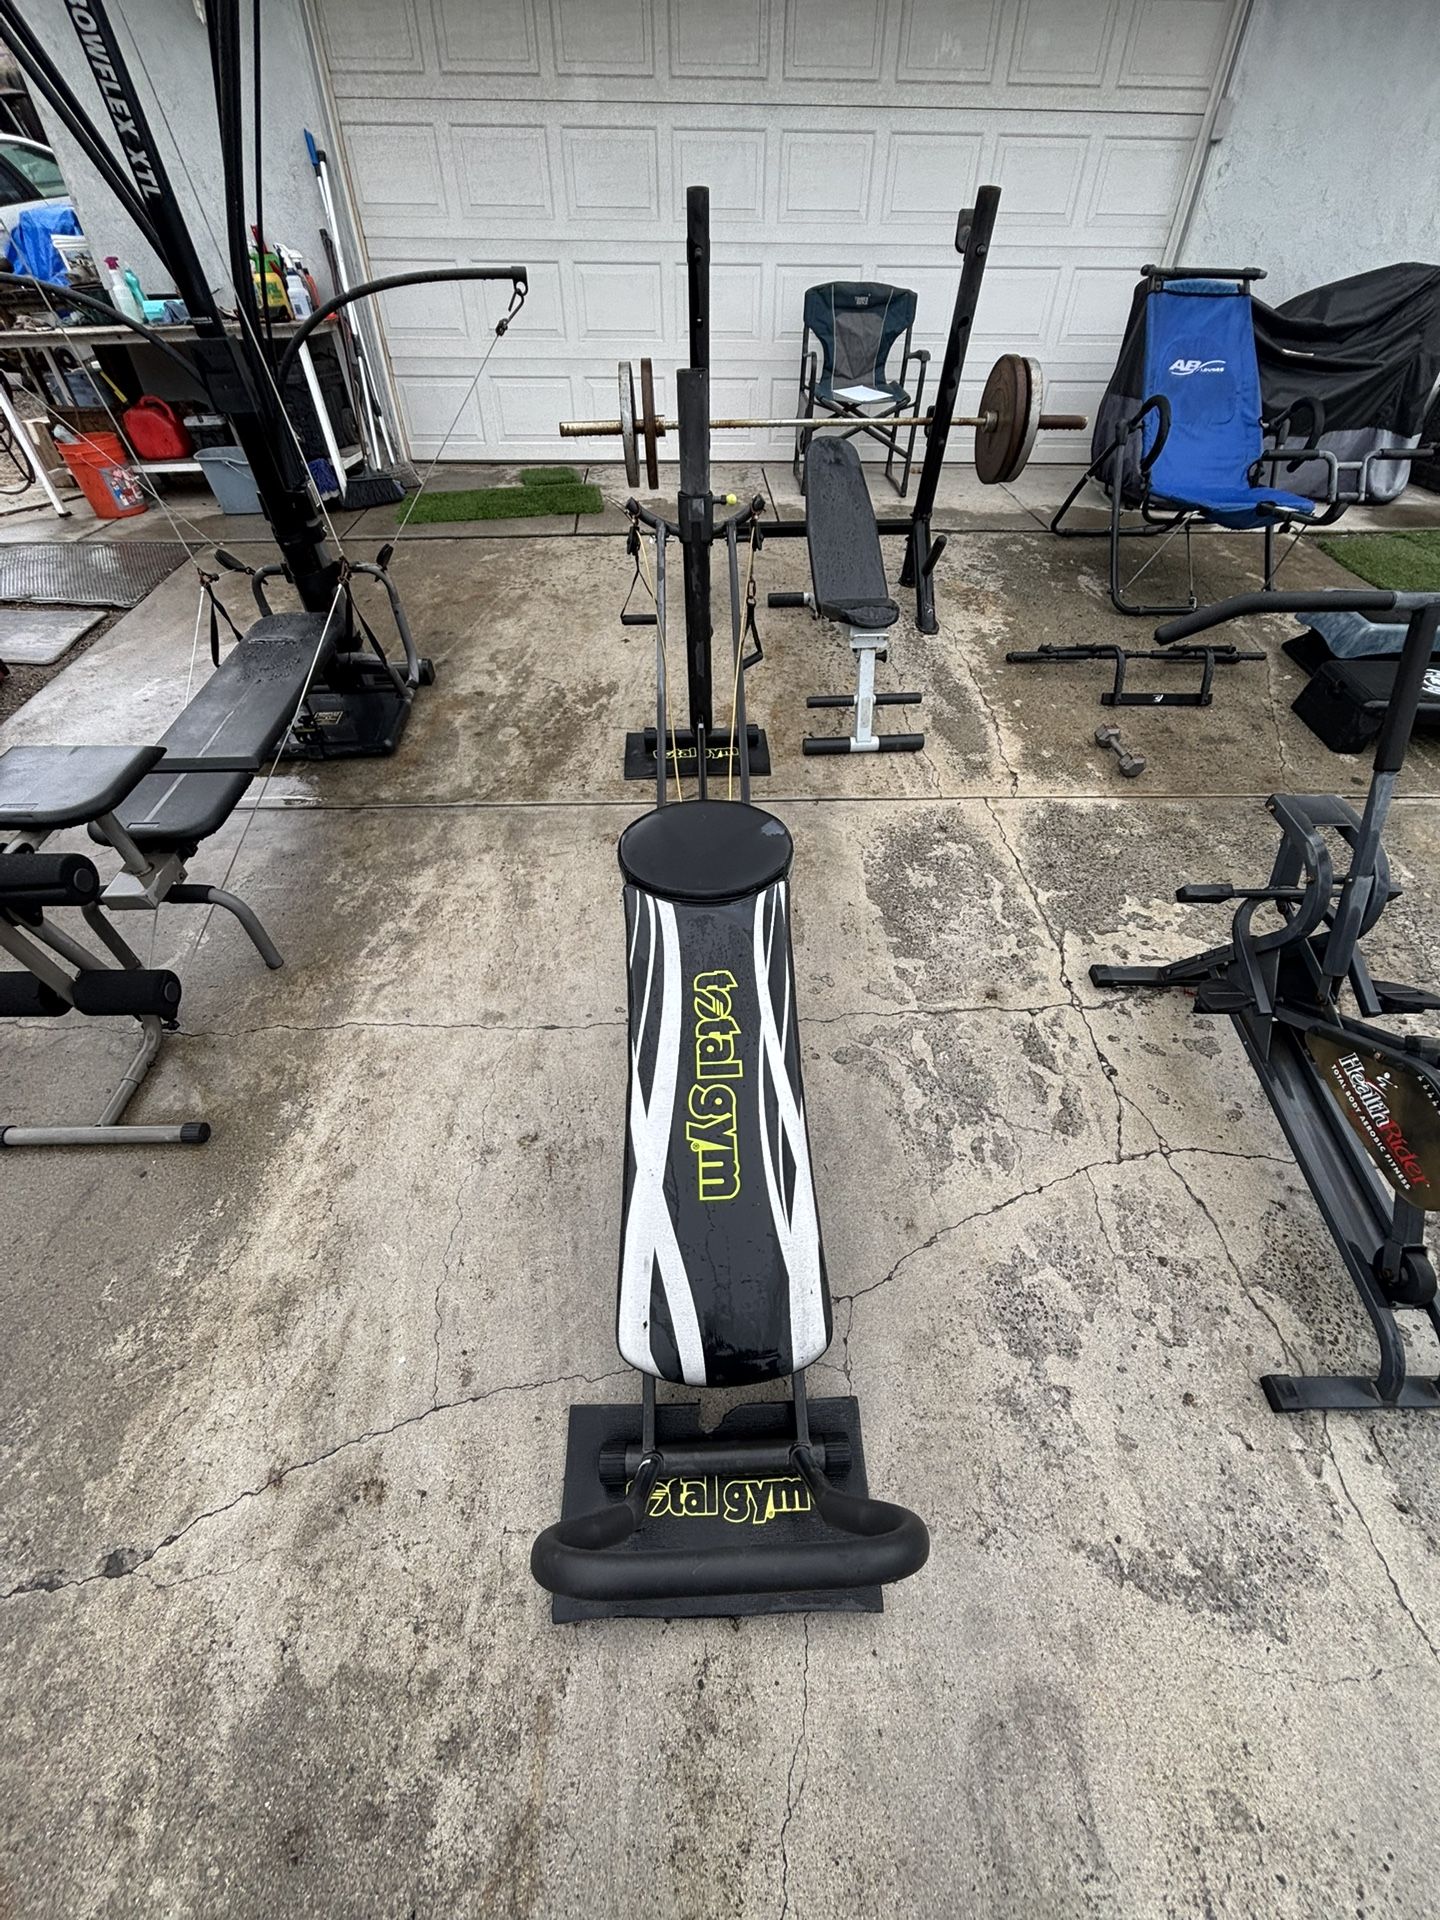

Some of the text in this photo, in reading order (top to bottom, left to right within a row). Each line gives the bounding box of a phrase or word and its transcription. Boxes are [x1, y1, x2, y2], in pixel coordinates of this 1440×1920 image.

[126, 145, 162, 200] XTL
[686, 970, 744, 1201] total gym
[1331, 1064, 1411, 1190] TOTAL BODY AEROBIC FITNESS
[723, 1477, 811, 1524] gym
